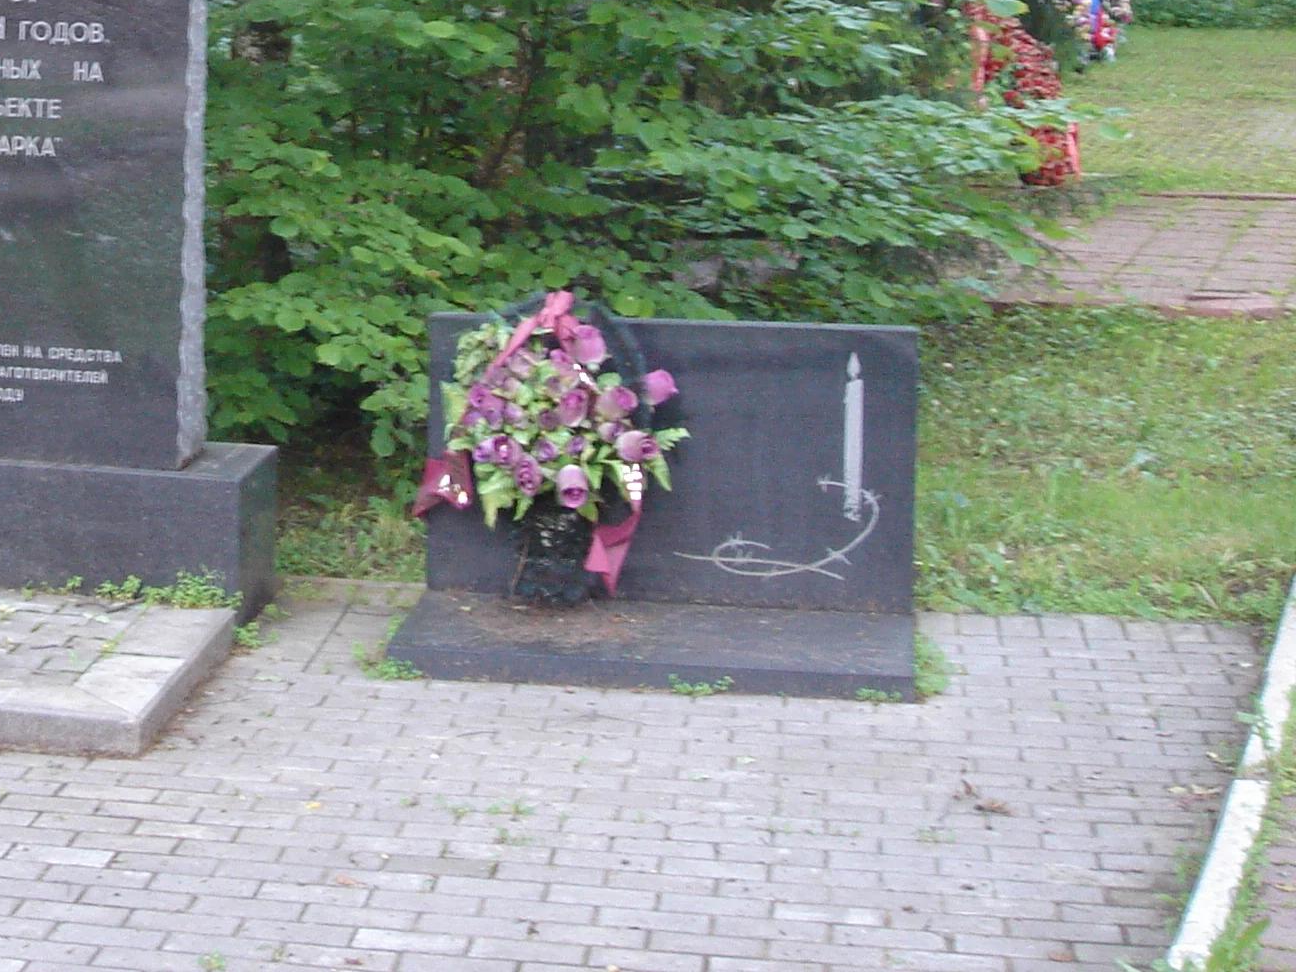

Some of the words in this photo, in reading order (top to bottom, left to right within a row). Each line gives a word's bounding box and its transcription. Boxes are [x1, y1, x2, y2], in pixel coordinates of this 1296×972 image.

[73, 61, 104, 82] НА
[23, 344, 44, 359] НА
[48, 346, 124, 364] СРЕДСТВА
